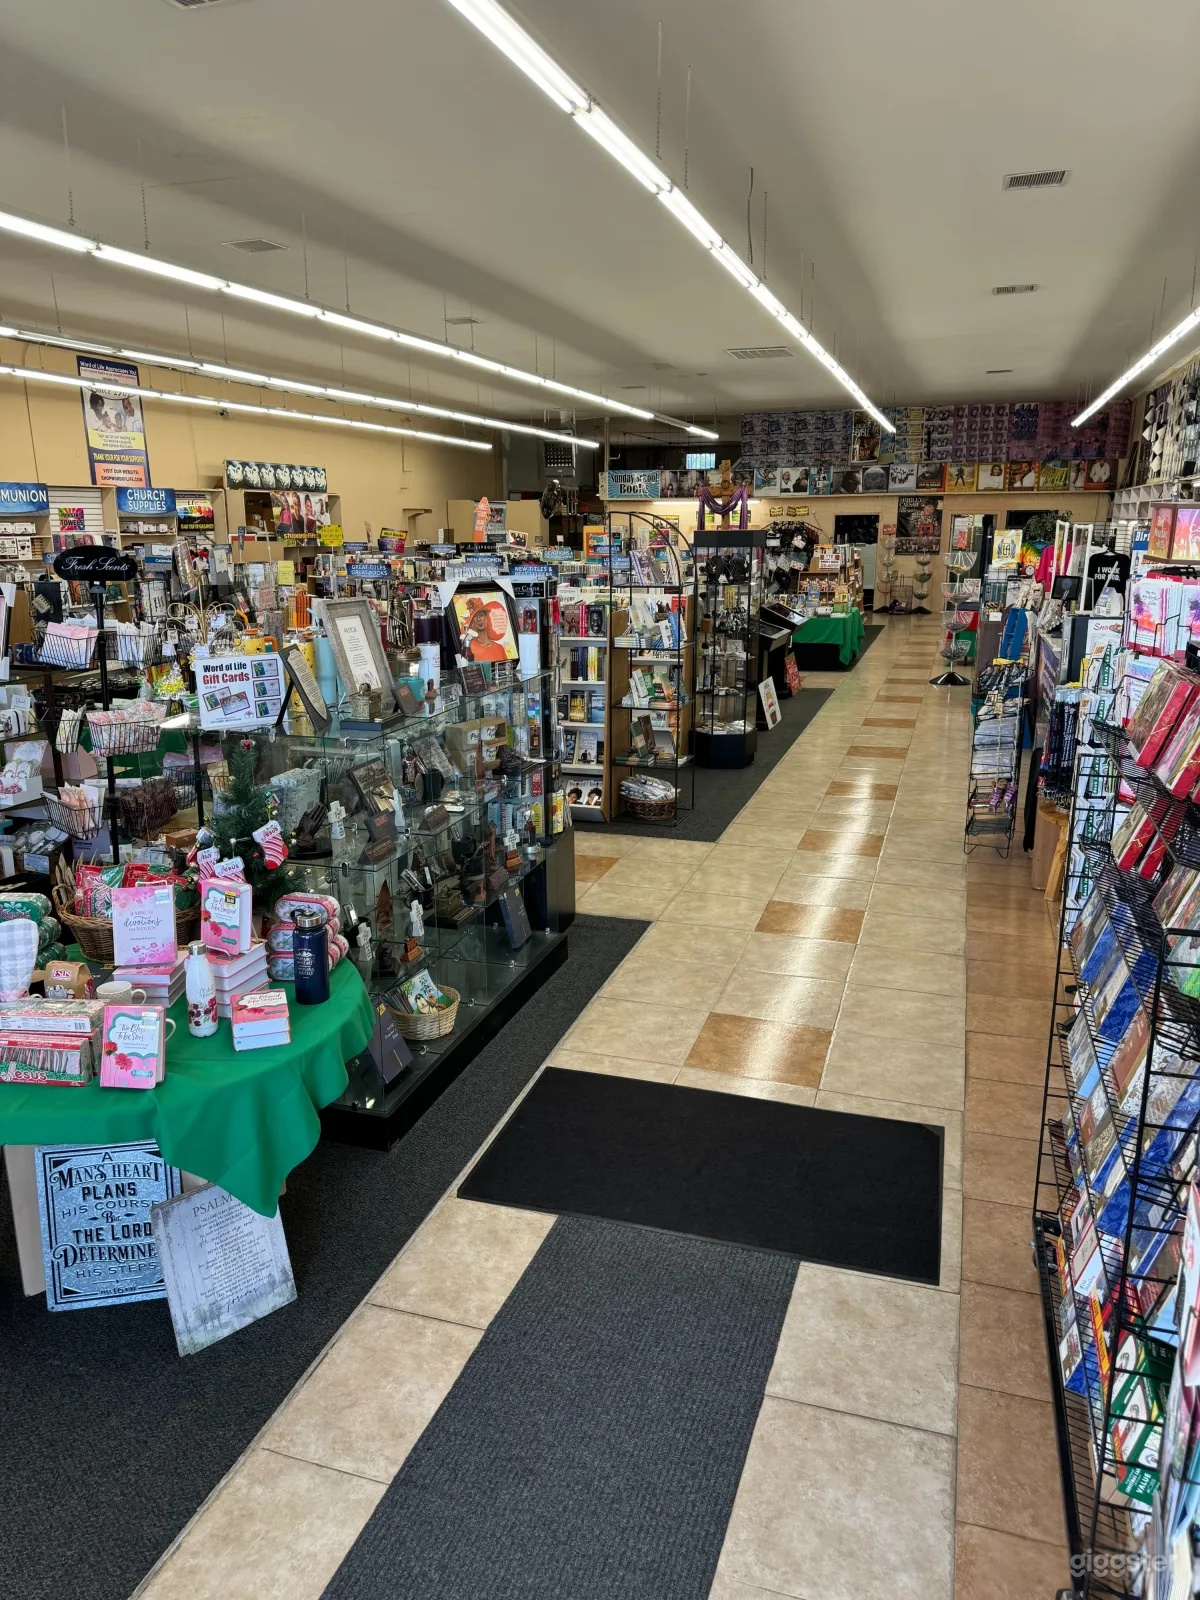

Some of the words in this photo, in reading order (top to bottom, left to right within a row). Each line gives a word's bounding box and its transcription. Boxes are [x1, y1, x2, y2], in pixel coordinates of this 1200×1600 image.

[105, 366, 128, 374] Appreciates
[610, 474, 634, 484] Sunday
[127, 489, 166, 500] CHURCH
[128, 501, 166, 510] SUPPLIES
[62, 556, 96, 570] Fresh
[96, 556, 130, 570] Scents
[203, 664, 223, 672] Word
[234, 662, 247, 670] Life
[203, 674, 219, 685] Gift
[222, 672, 250, 683] Cards
[124, 916, 163, 927] devotions
[102, 1152, 113, 1162] A
[112, 1162, 162, 1182] HEART
[82, 1182, 137, 1200] PLANS
[62, 1205, 88, 1218] HIS
[192, 1194, 233, 1217] PSALM
[73, 1227, 106, 1244] THE
[111, 1222, 153, 1241] LORD
[53, 1243, 158, 1268] DETERMINE
[76, 1269, 102, 1278] HIS
[108, 1262, 157, 1274] STEPS
[1136, 1472, 1152, 1494] VALUE
